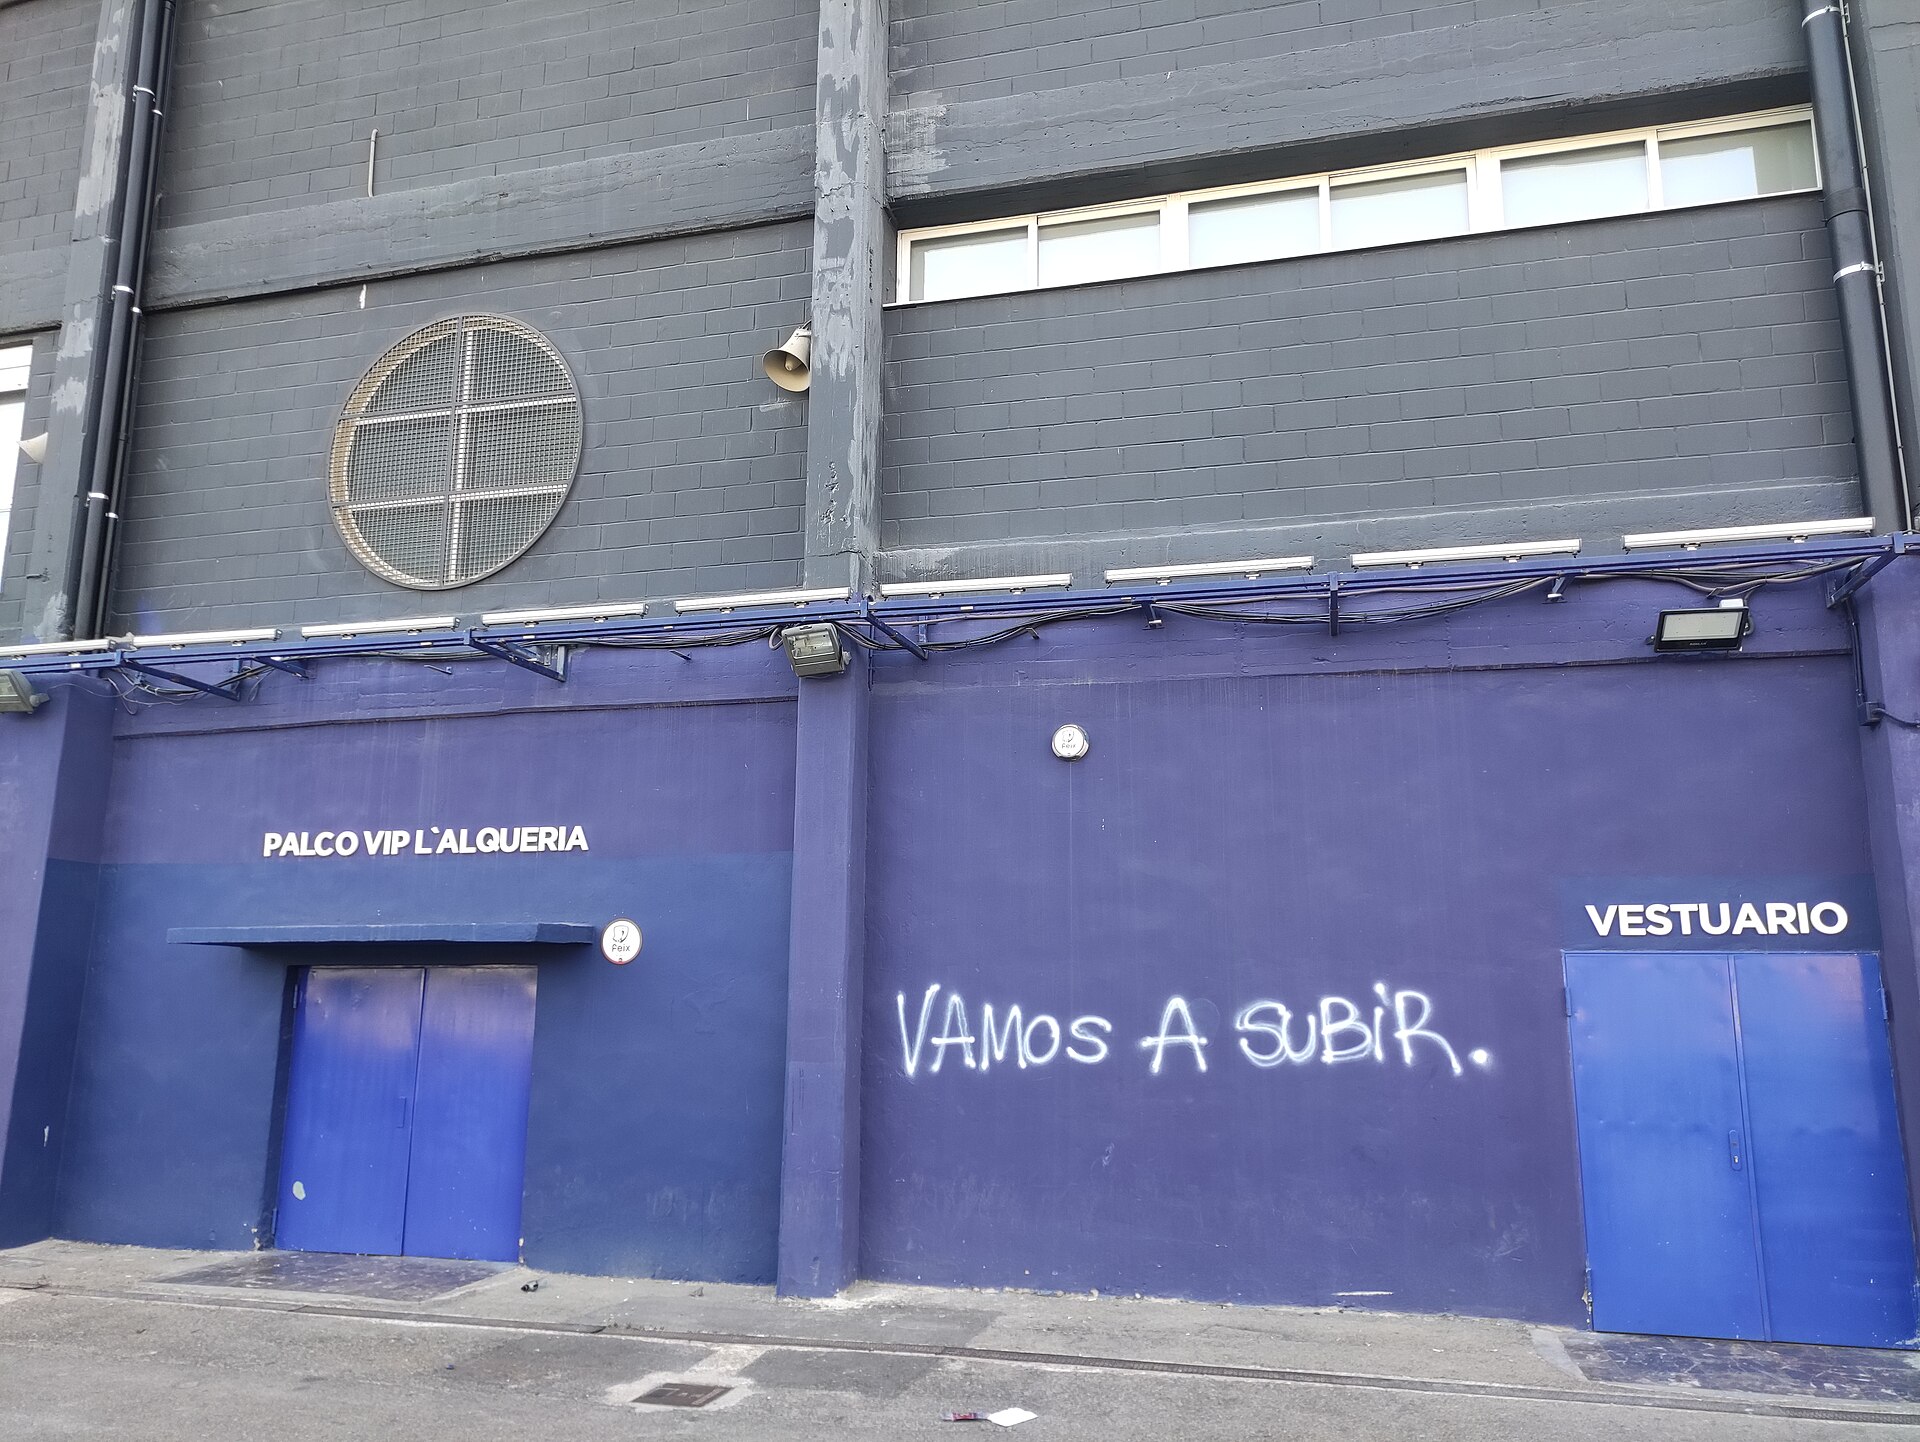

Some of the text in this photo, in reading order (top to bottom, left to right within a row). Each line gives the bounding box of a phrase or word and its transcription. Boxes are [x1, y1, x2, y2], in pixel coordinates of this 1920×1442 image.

[262, 829, 359, 857] PALCO
[364, 830, 411, 855] VIP
[1585, 901, 1849, 936] VESTUARIO
[897, 983, 1112, 1075] VAMOS
[1142, 996, 1208, 1073] A
